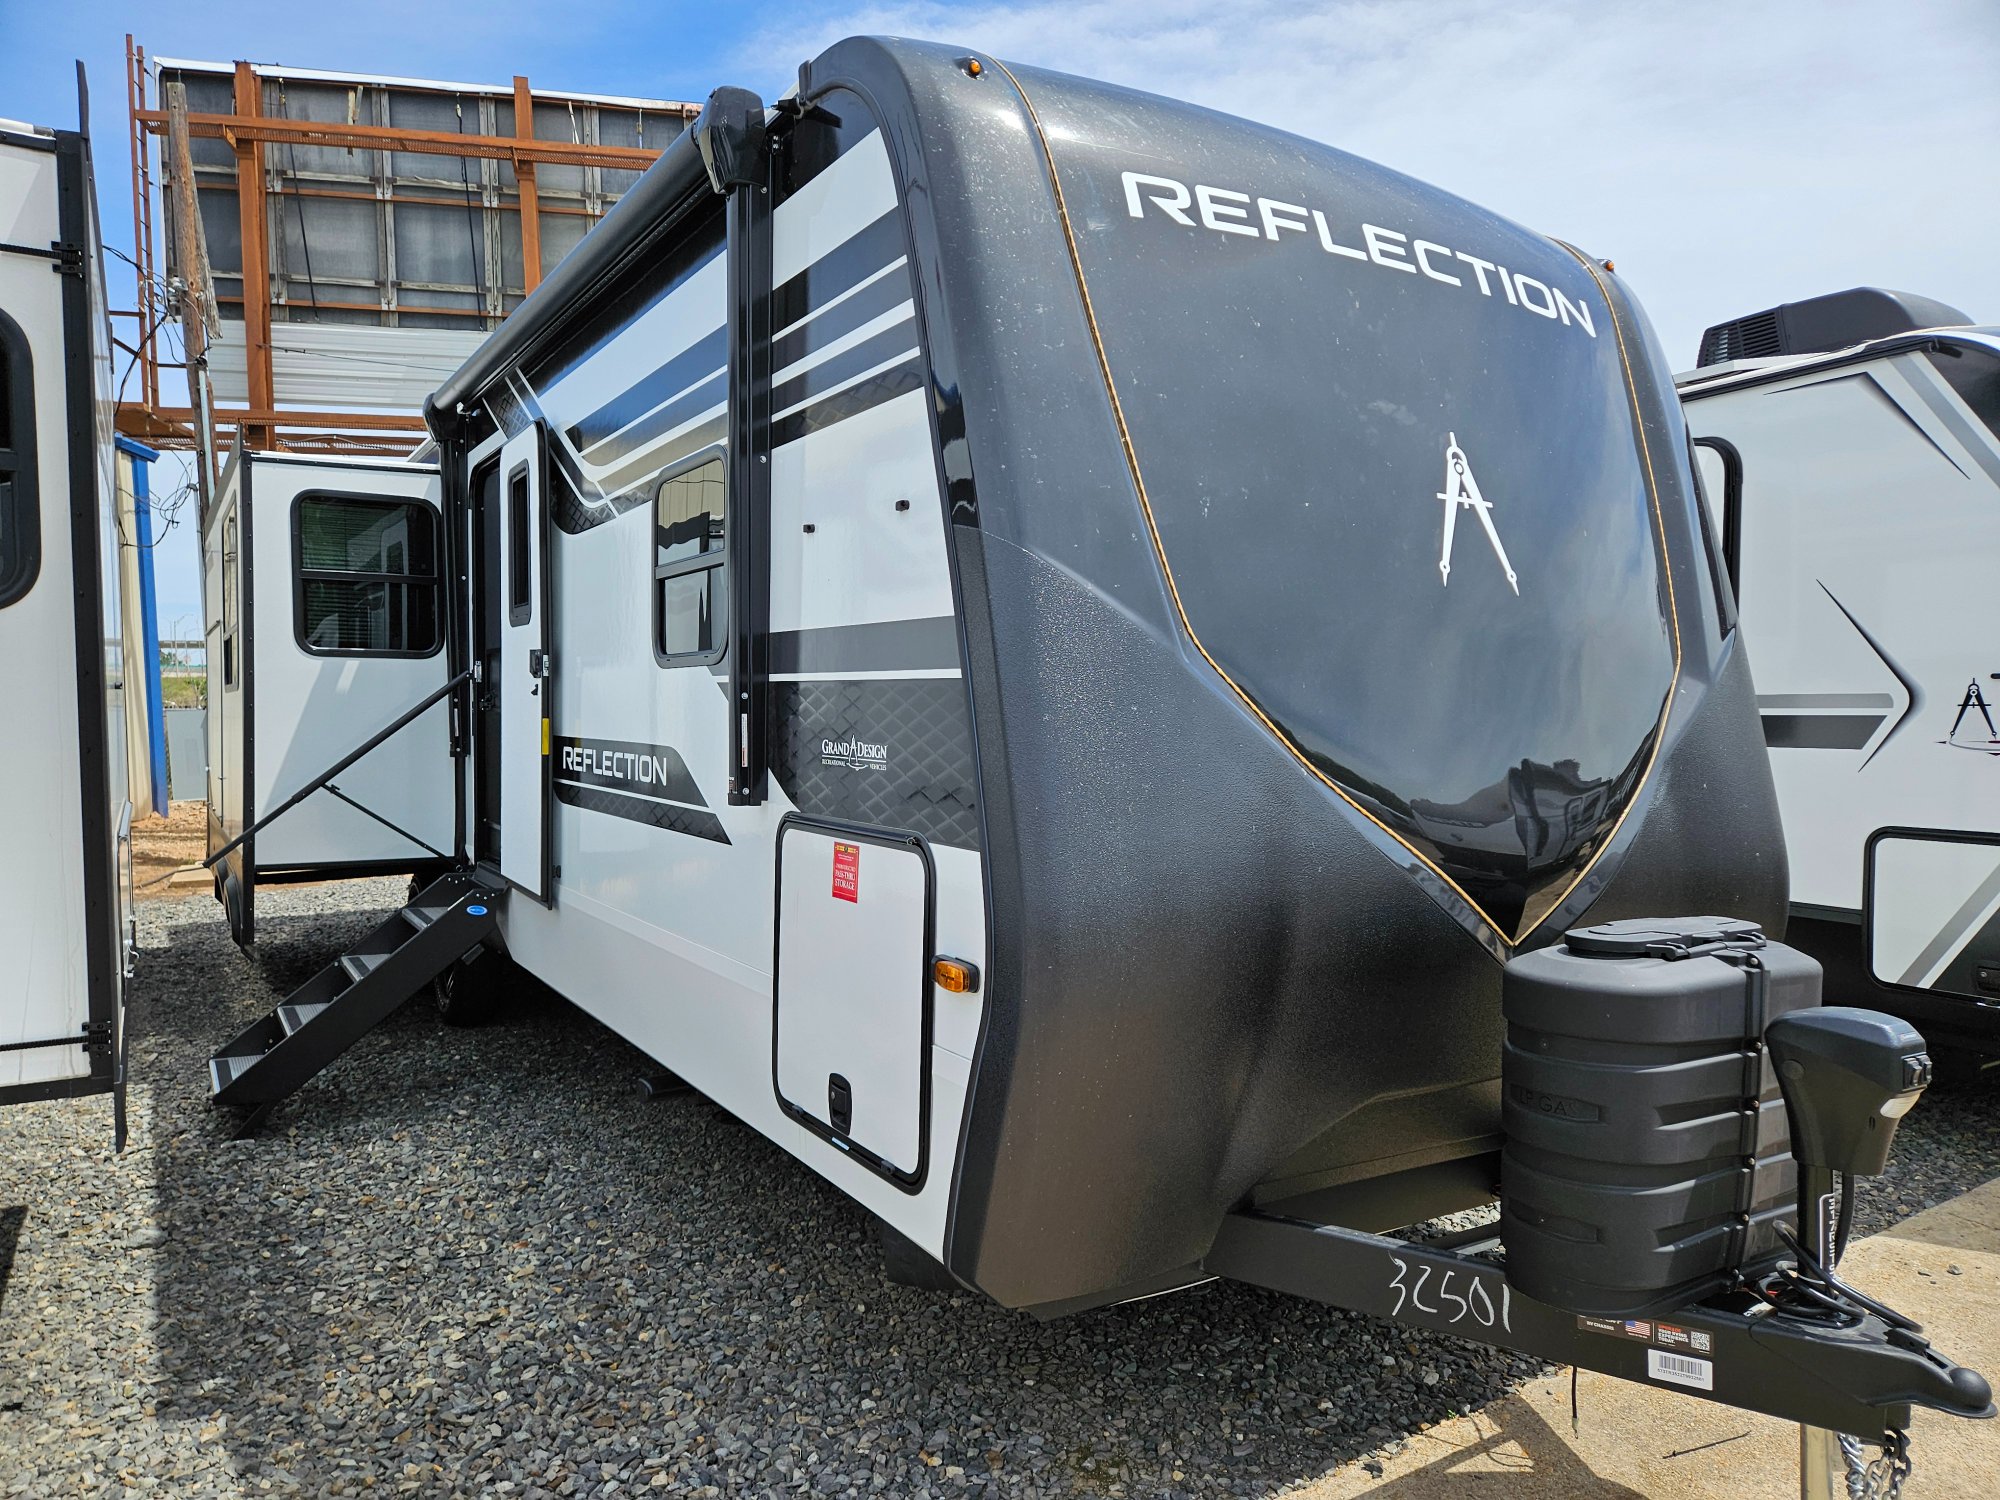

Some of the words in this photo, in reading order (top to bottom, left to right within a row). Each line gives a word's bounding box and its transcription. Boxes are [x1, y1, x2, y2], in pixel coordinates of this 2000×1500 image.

[1121, 171, 1597, 338] REFLECTION
[562, 745, 667, 787] REFLECTION
[822, 739, 850, 756] GRAND
[857, 741, 887, 759] DESIGN
[1388, 1250, 1512, 1334] 32501
